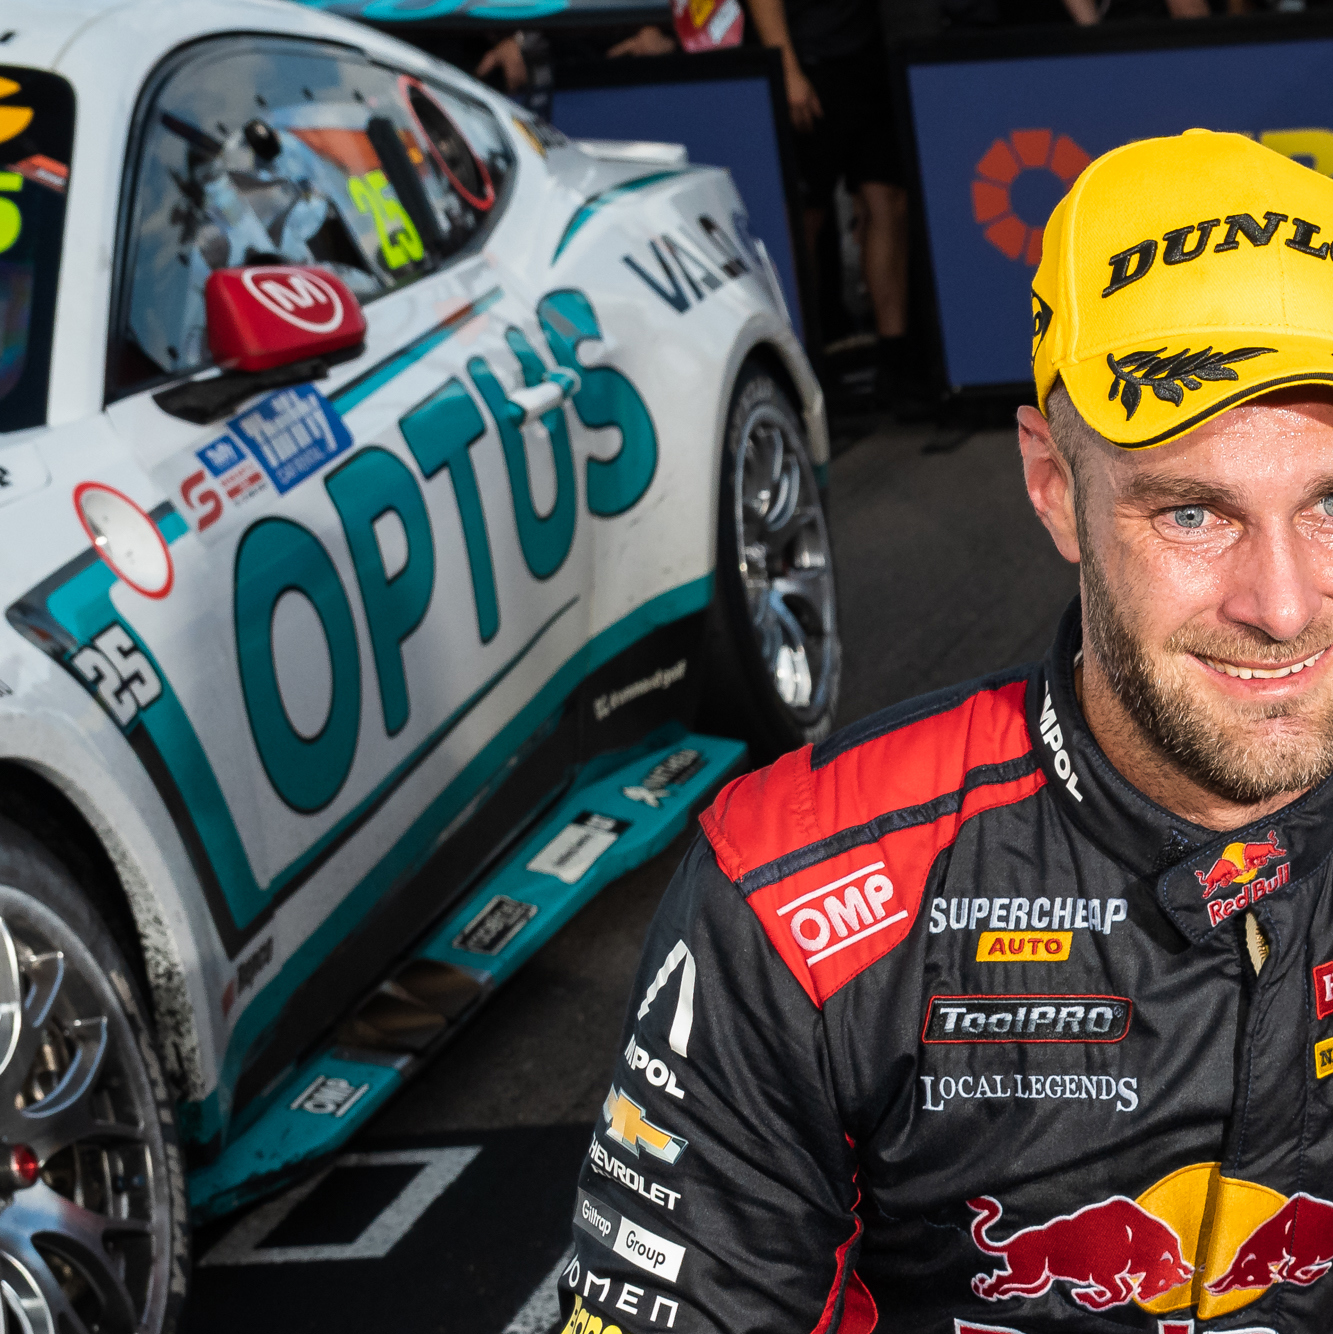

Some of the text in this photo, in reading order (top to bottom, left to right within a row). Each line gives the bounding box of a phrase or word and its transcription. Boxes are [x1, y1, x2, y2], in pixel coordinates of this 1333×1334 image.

[348, 170, 424, 270] 25
[234, 289, 659, 815] OPTUS
[72, 622, 163, 728] 25
[1039, 682, 1083, 802] MPOL
[789, 873, 895, 952] OMP
[928, 896, 1128, 935] SUPERCHEAP
[1207, 862, 1291, 927] Red Bull
[987, 937, 1064, 957] AUTO
[624, 1034, 685, 1099] MPOL
[921, 1074, 1138, 1113] LOCAL LEGENDS
[589, 1131, 682, 1211] HEVROLET
[581, 1199, 666, 1269] Giltrap Group
